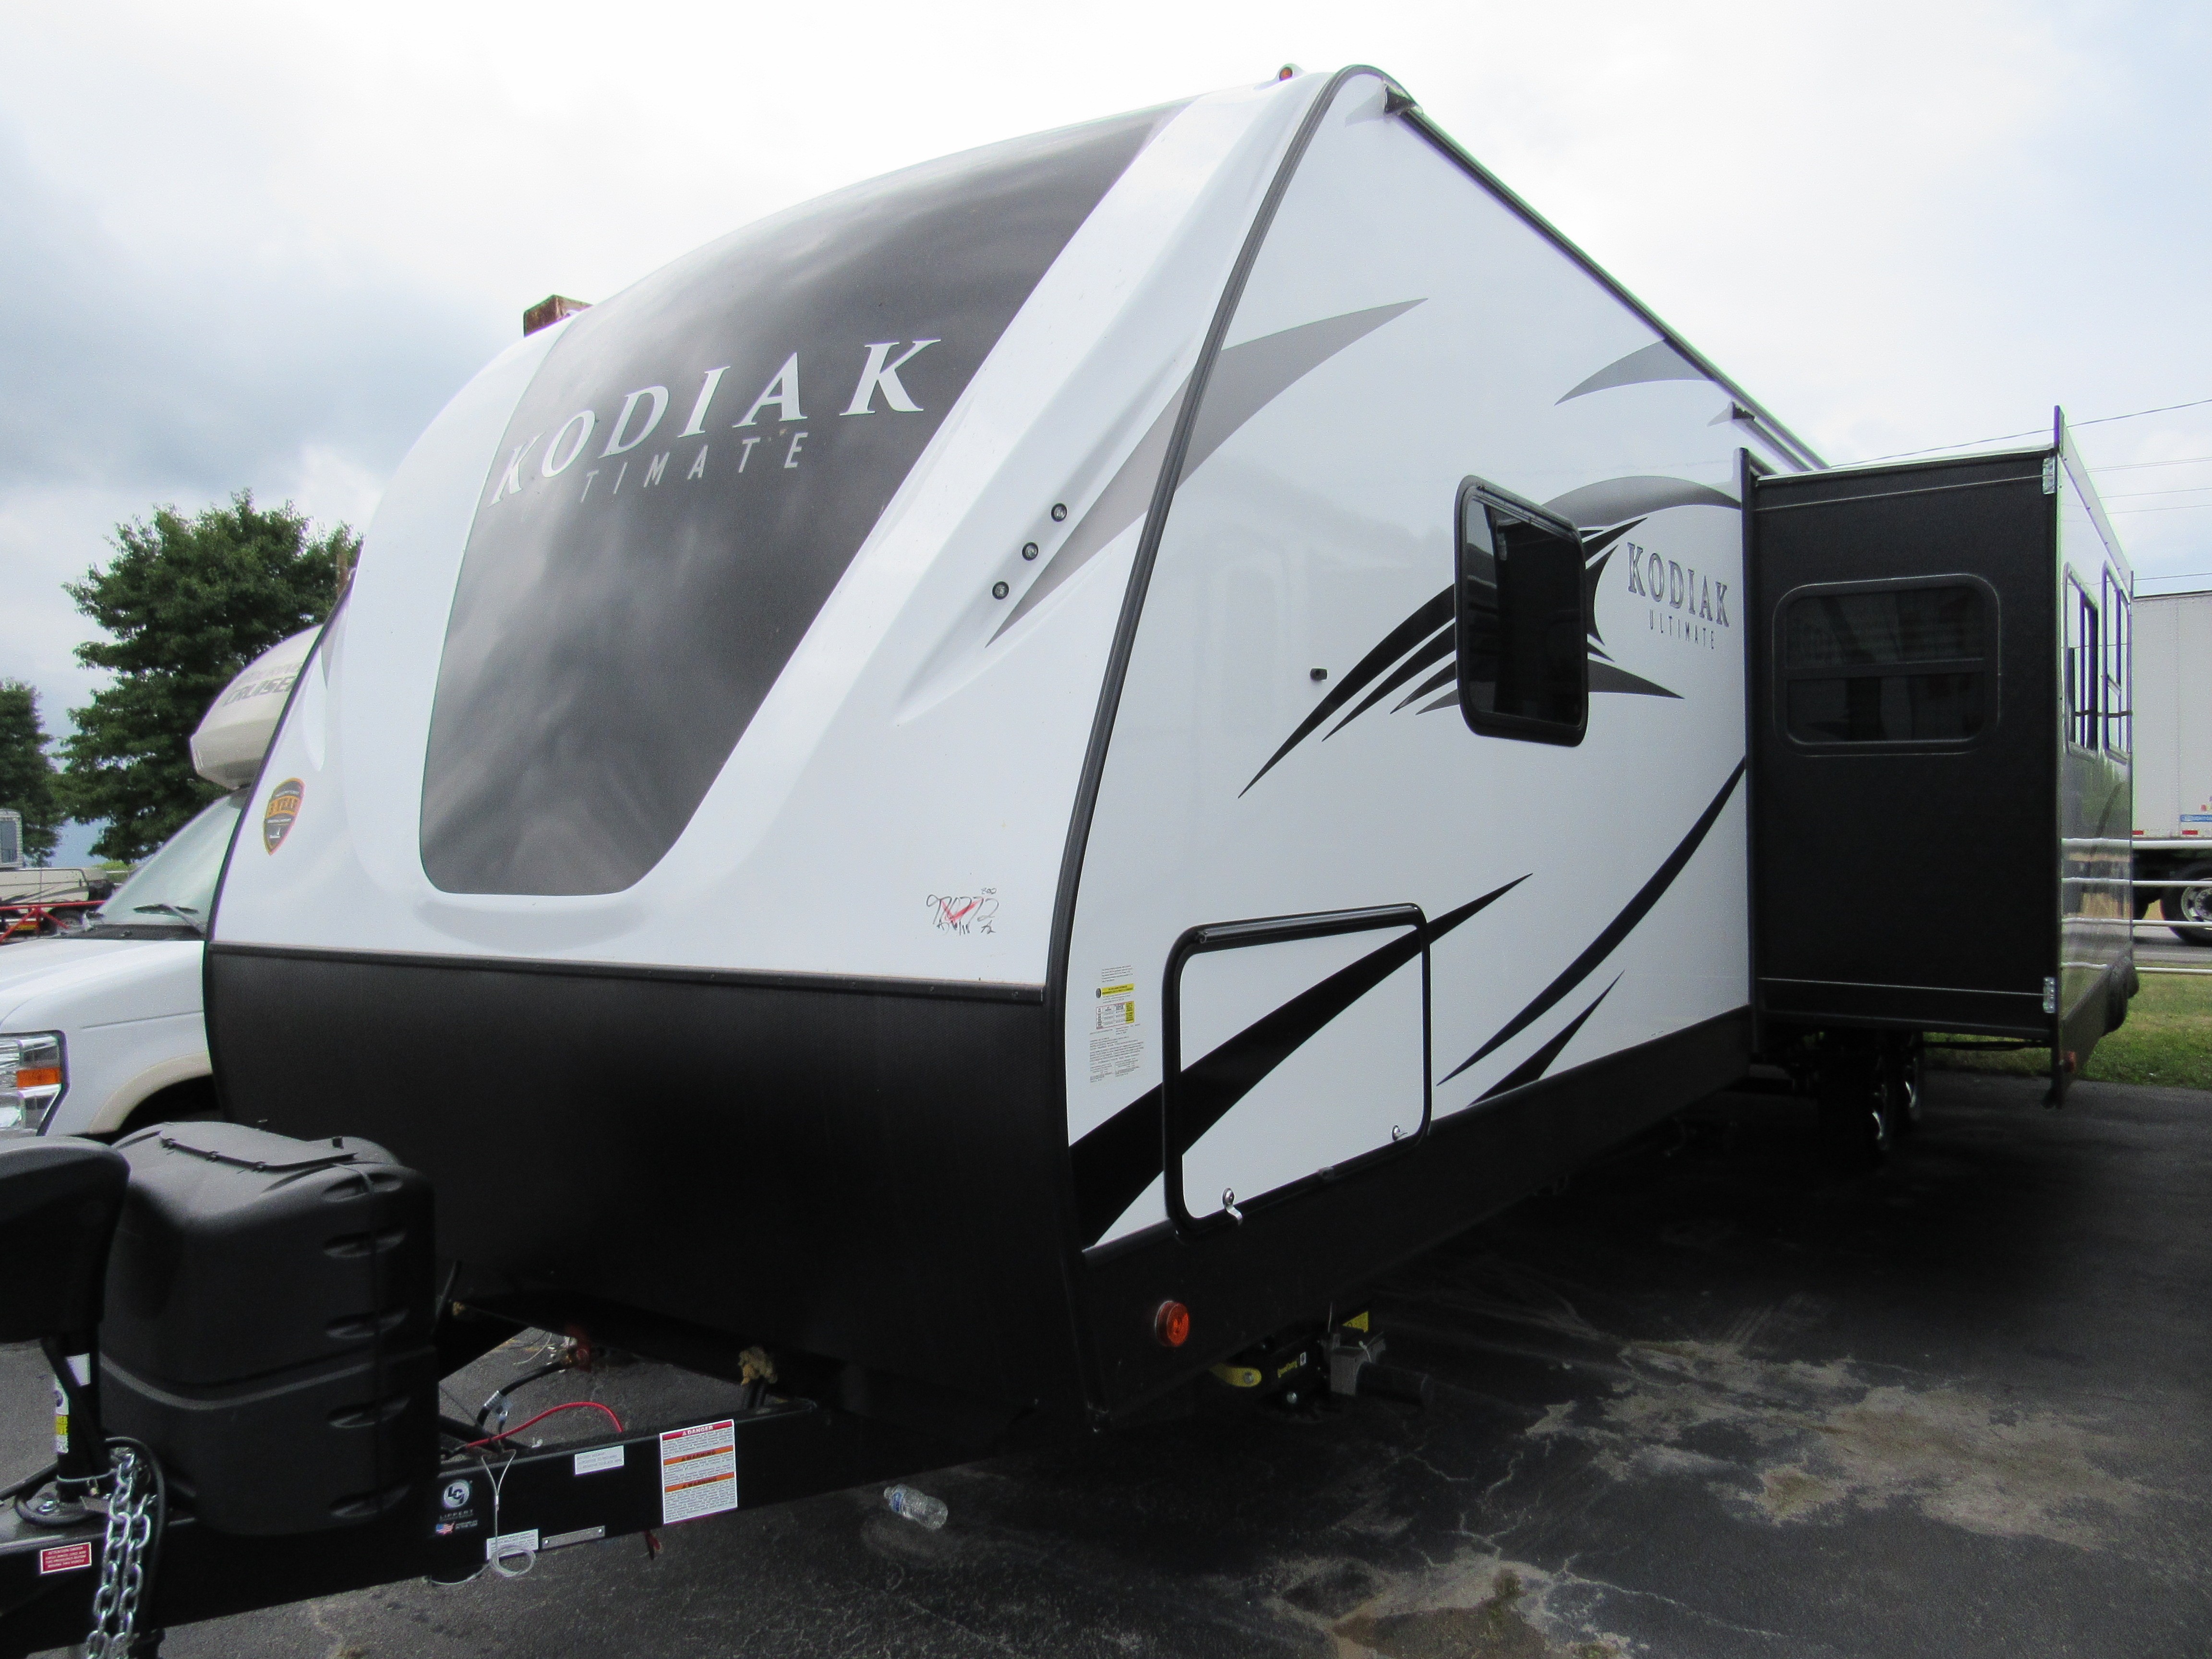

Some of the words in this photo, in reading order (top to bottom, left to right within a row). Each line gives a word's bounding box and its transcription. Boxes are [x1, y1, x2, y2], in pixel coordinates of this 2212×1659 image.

[488, 339, 941, 508] KODIAK
[1627, 541, 1729, 627] KODIAK
[687, 1425, 713, 1435] DANGER
